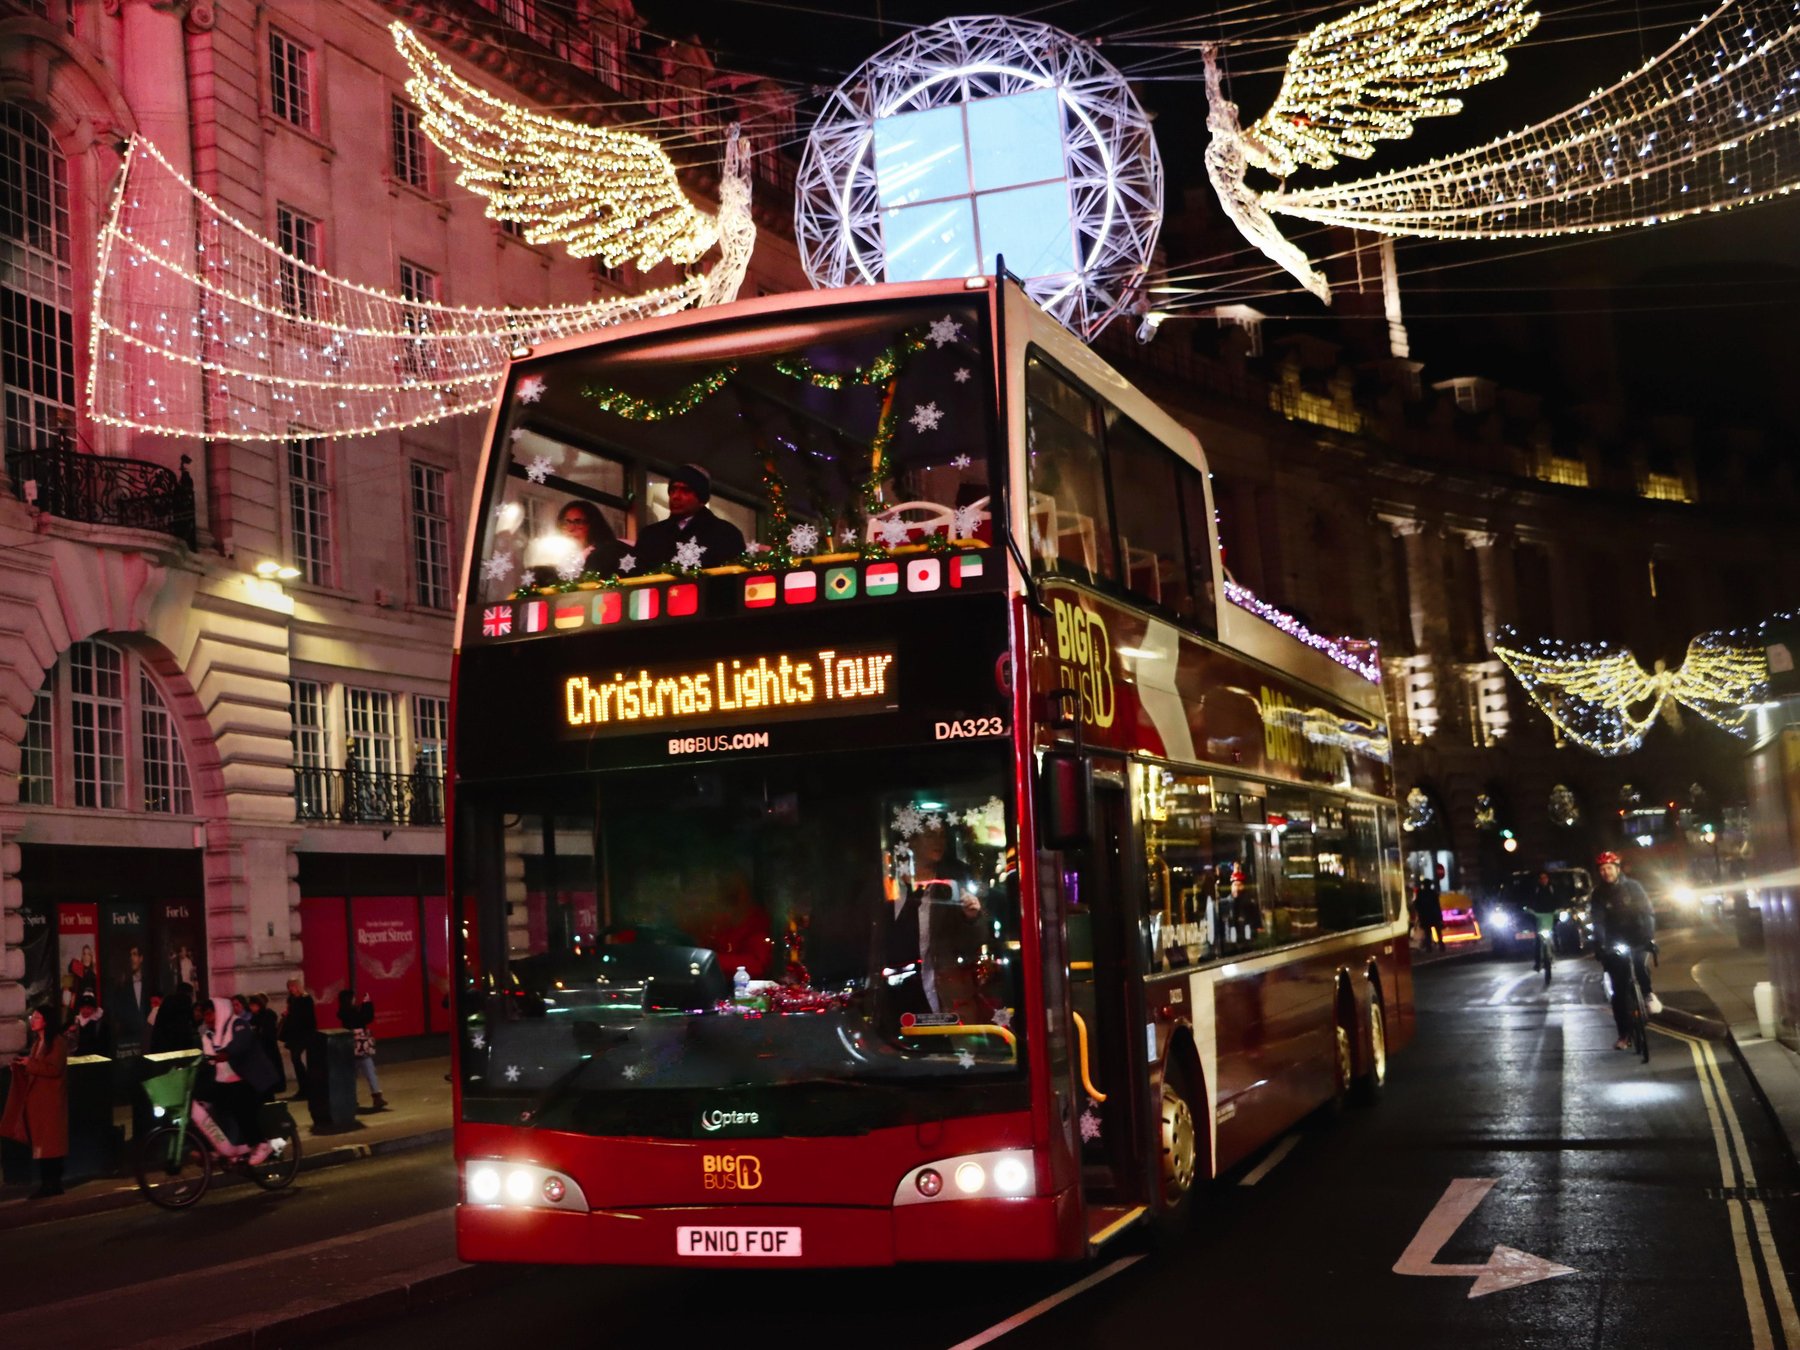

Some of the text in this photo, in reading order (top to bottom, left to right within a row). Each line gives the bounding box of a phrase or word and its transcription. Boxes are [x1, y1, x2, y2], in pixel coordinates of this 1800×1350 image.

[1054, 598, 1088, 665] BIG
[566, 651, 892, 725] Christmas Lights Tour
[935, 717, 1003, 740] DA323
[668, 732, 769, 755] BIGBUS.COM
[61, 912, 93, 925] For You
[112, 912, 139, 925] For Me
[166, 906, 178, 918] For
[358, 928, 413, 946] Regent Street
[711, 1110, 759, 1127] Optare
[703, 1155, 736, 1173] BIG
[704, 1173, 737, 1189] BUS
[690, 1230, 788, 1252] PN10 FOF
